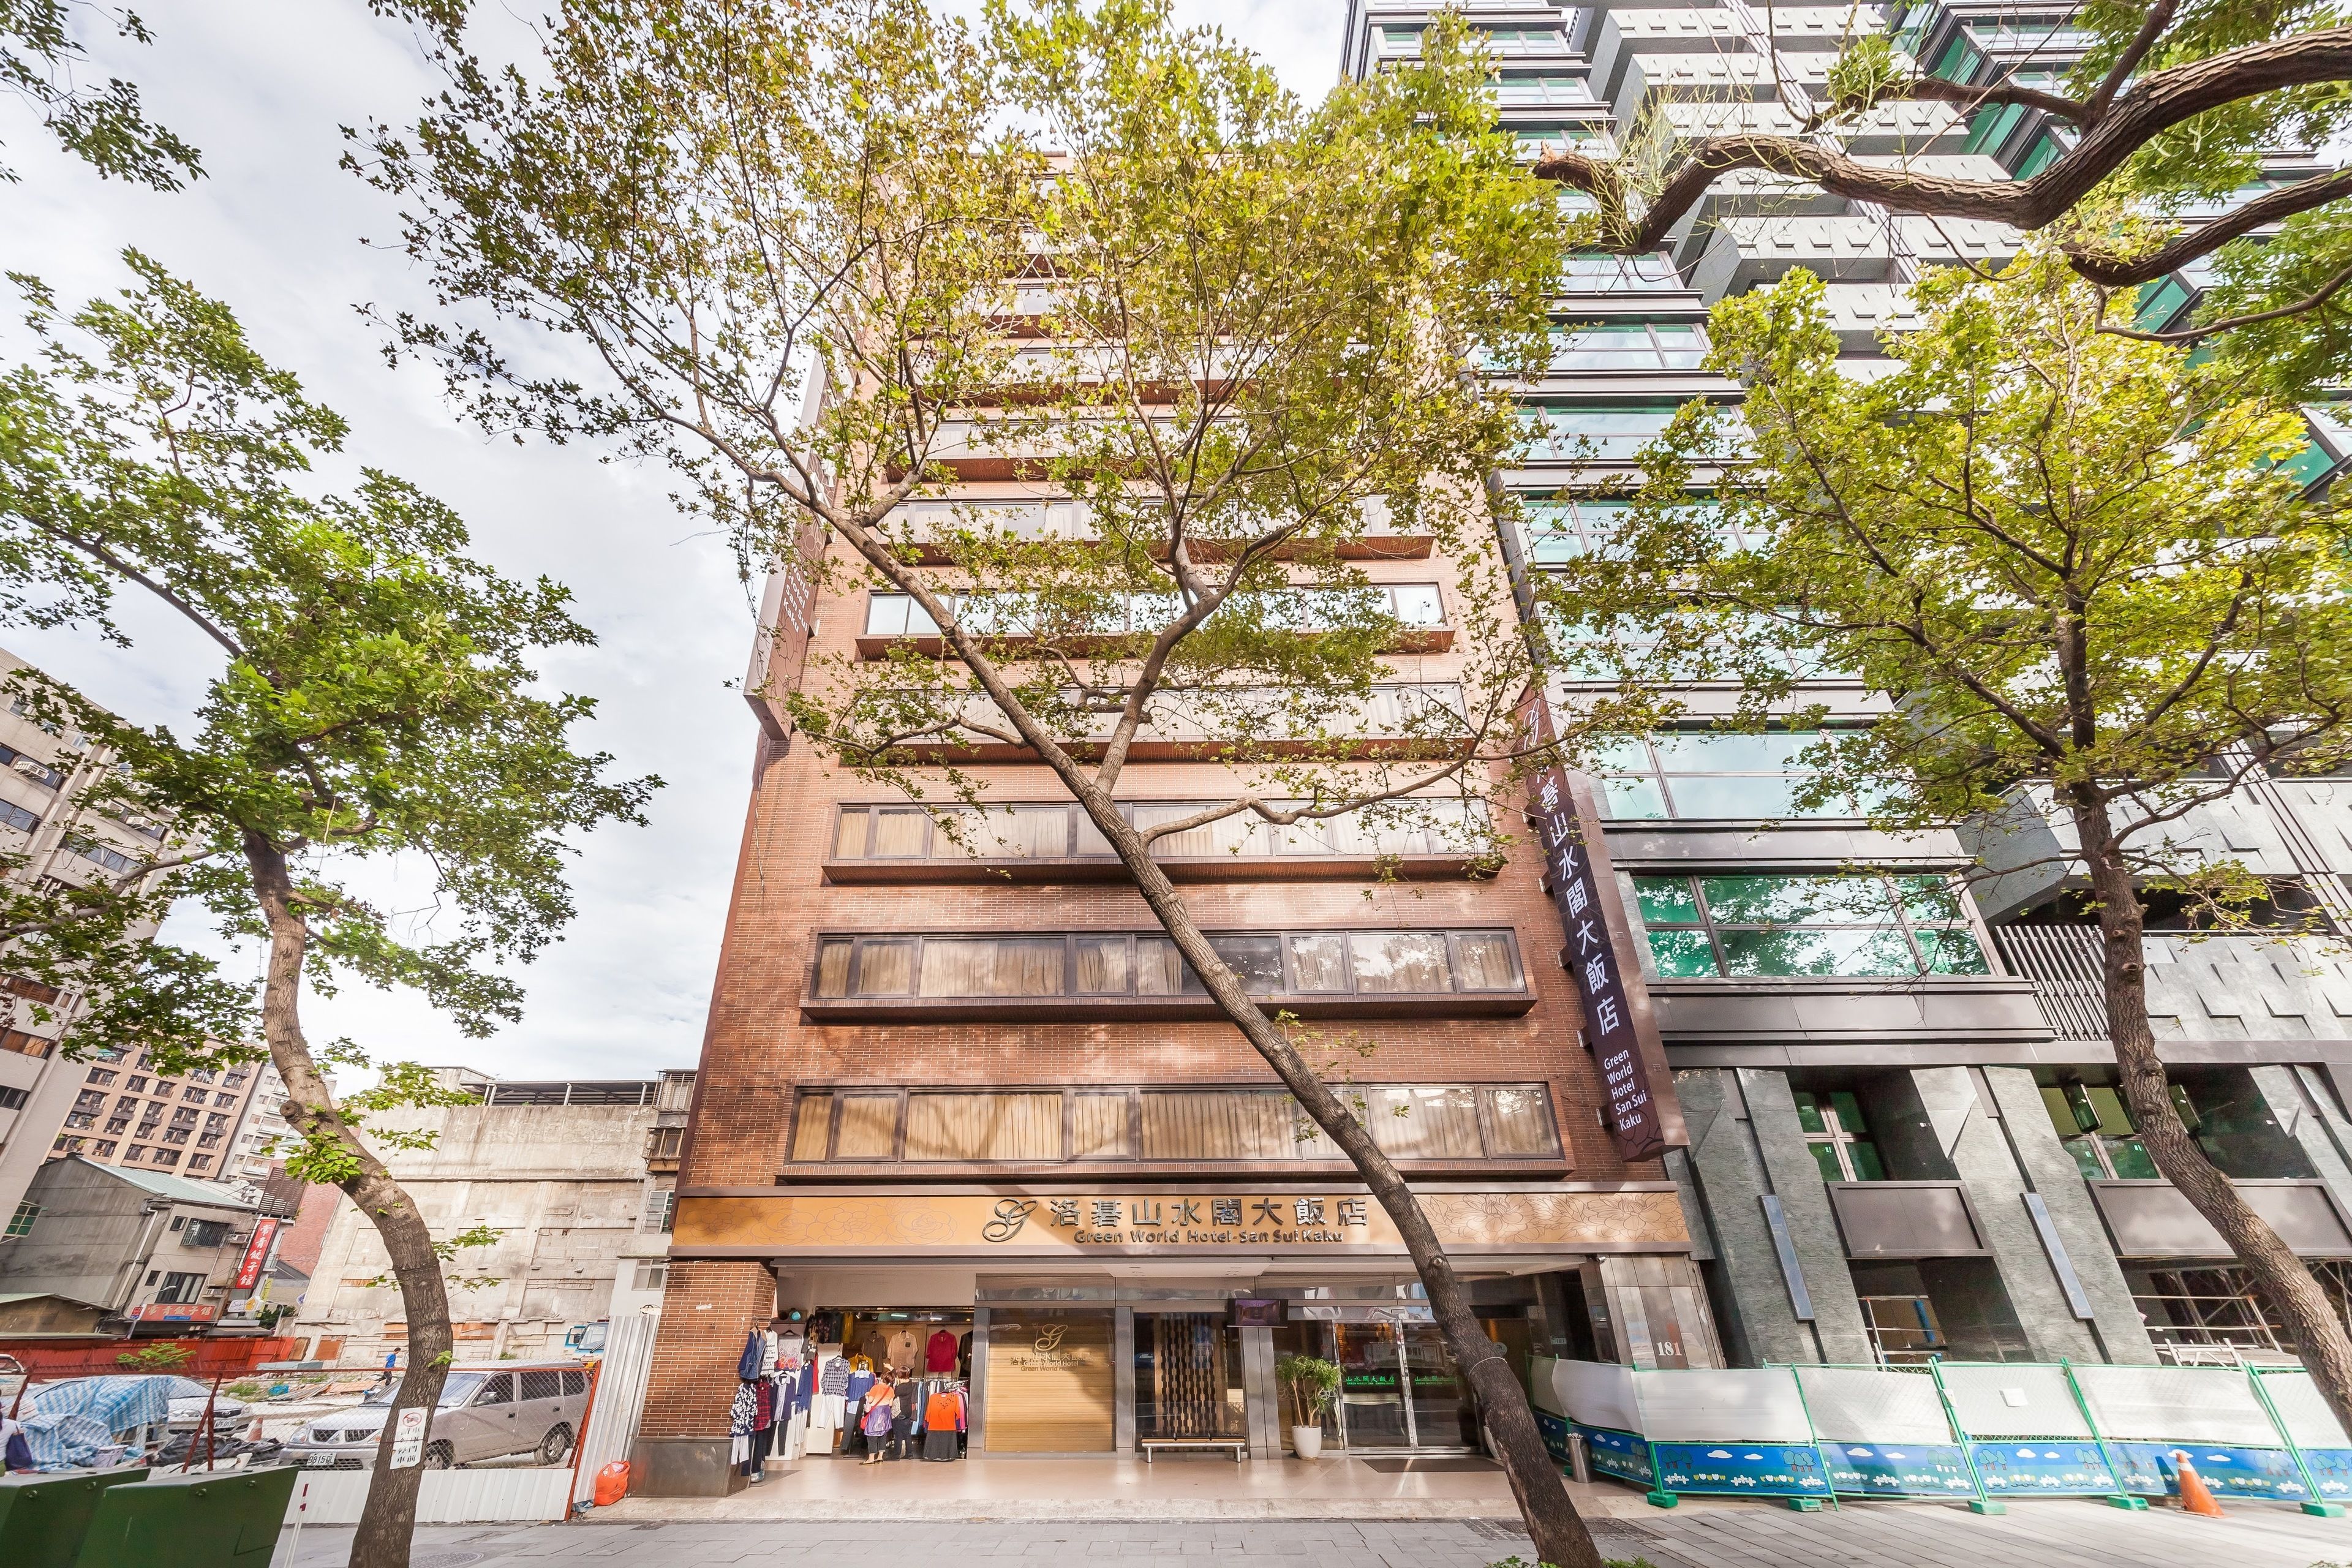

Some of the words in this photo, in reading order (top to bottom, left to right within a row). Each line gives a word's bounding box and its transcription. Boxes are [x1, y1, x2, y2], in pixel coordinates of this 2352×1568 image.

[783, 597, 799, 633] Kaku
[785, 584, 797, 612] San
[797, 609, 808, 632] Sui
[1536, 765, 1619, 1036] 碁山水閣大飯店
[1604, 1049, 1629, 1070] Green
[1607, 1061, 1633, 1085] World
[1611, 1077, 1635, 1100] Hotel
[1615, 1100, 1632, 1115] San
[1632, 1090, 1647, 1107] Sui
[1619, 1113, 1642, 1131] Kaku
[1049, 1197, 1367, 1227] 洛碁山水閣大飯店
[1074, 1230, 1123, 1243] Green
[1131, 1229, 1179, 1243] World
[1273, 1228, 1299, 1243] Sui
[1303, 1229, 1344, 1243] Kaku
[240, 1224, 273, 1286] 常青餃子館
[1656, 1341, 1683, 1356] 181
